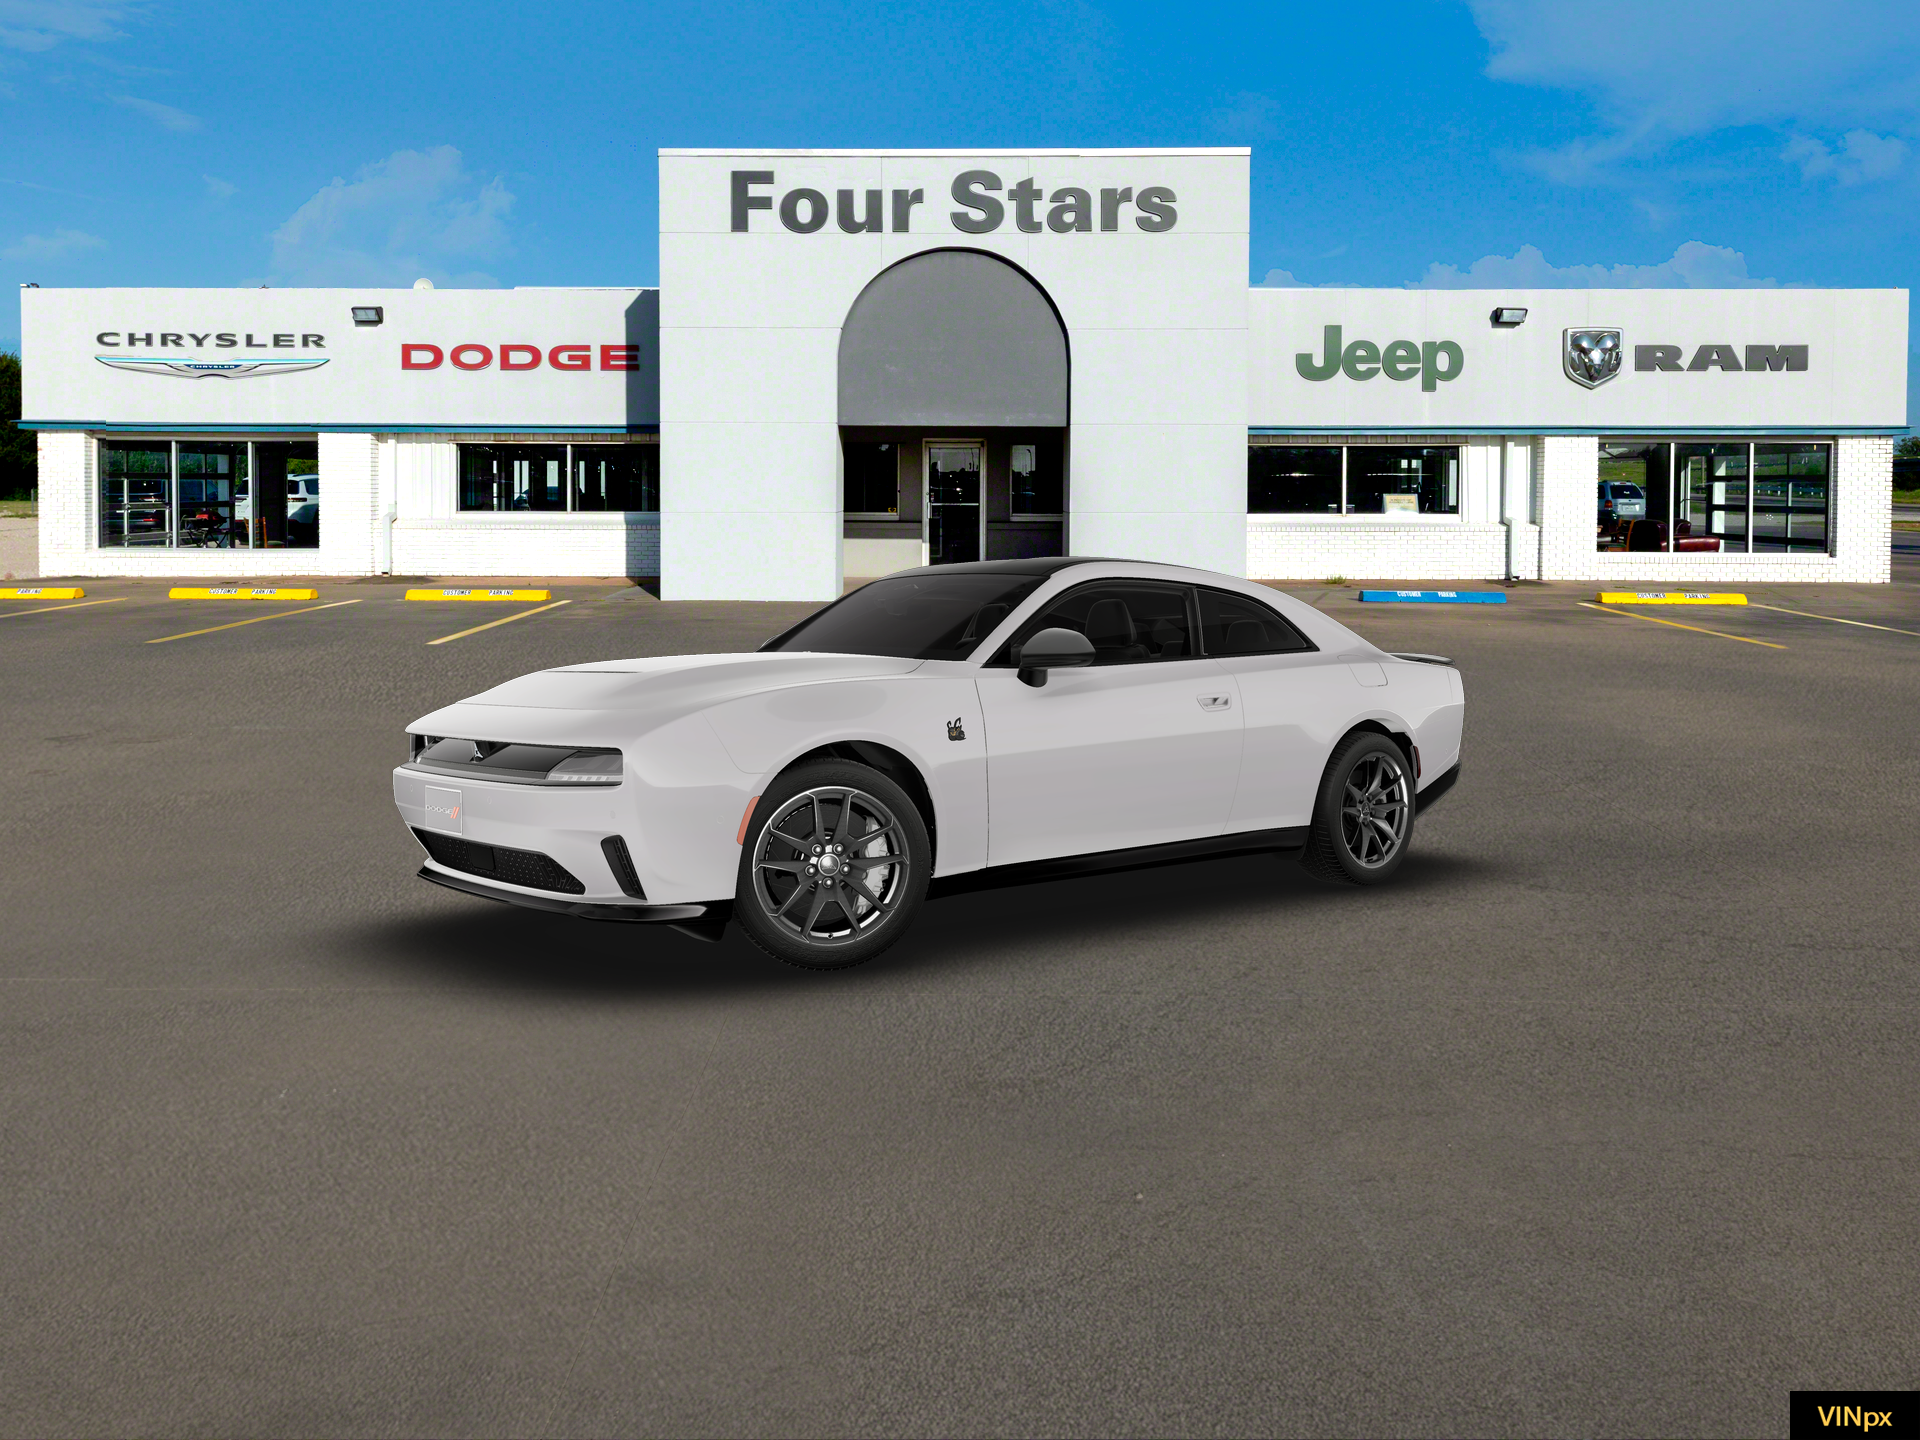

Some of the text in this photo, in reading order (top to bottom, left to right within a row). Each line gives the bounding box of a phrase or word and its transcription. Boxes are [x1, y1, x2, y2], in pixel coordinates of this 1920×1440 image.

[730, 169, 1178, 234] Four Stars
[96, 331, 326, 349] CHRYSLER
[401, 343, 640, 372] DODGE
[1295, 324, 1464, 392] Jeep
[1634, 344, 1809, 372] RAM
[1397, 590, 1422, 598] CUSTOMER
[425, 804, 453, 815] DODGE
